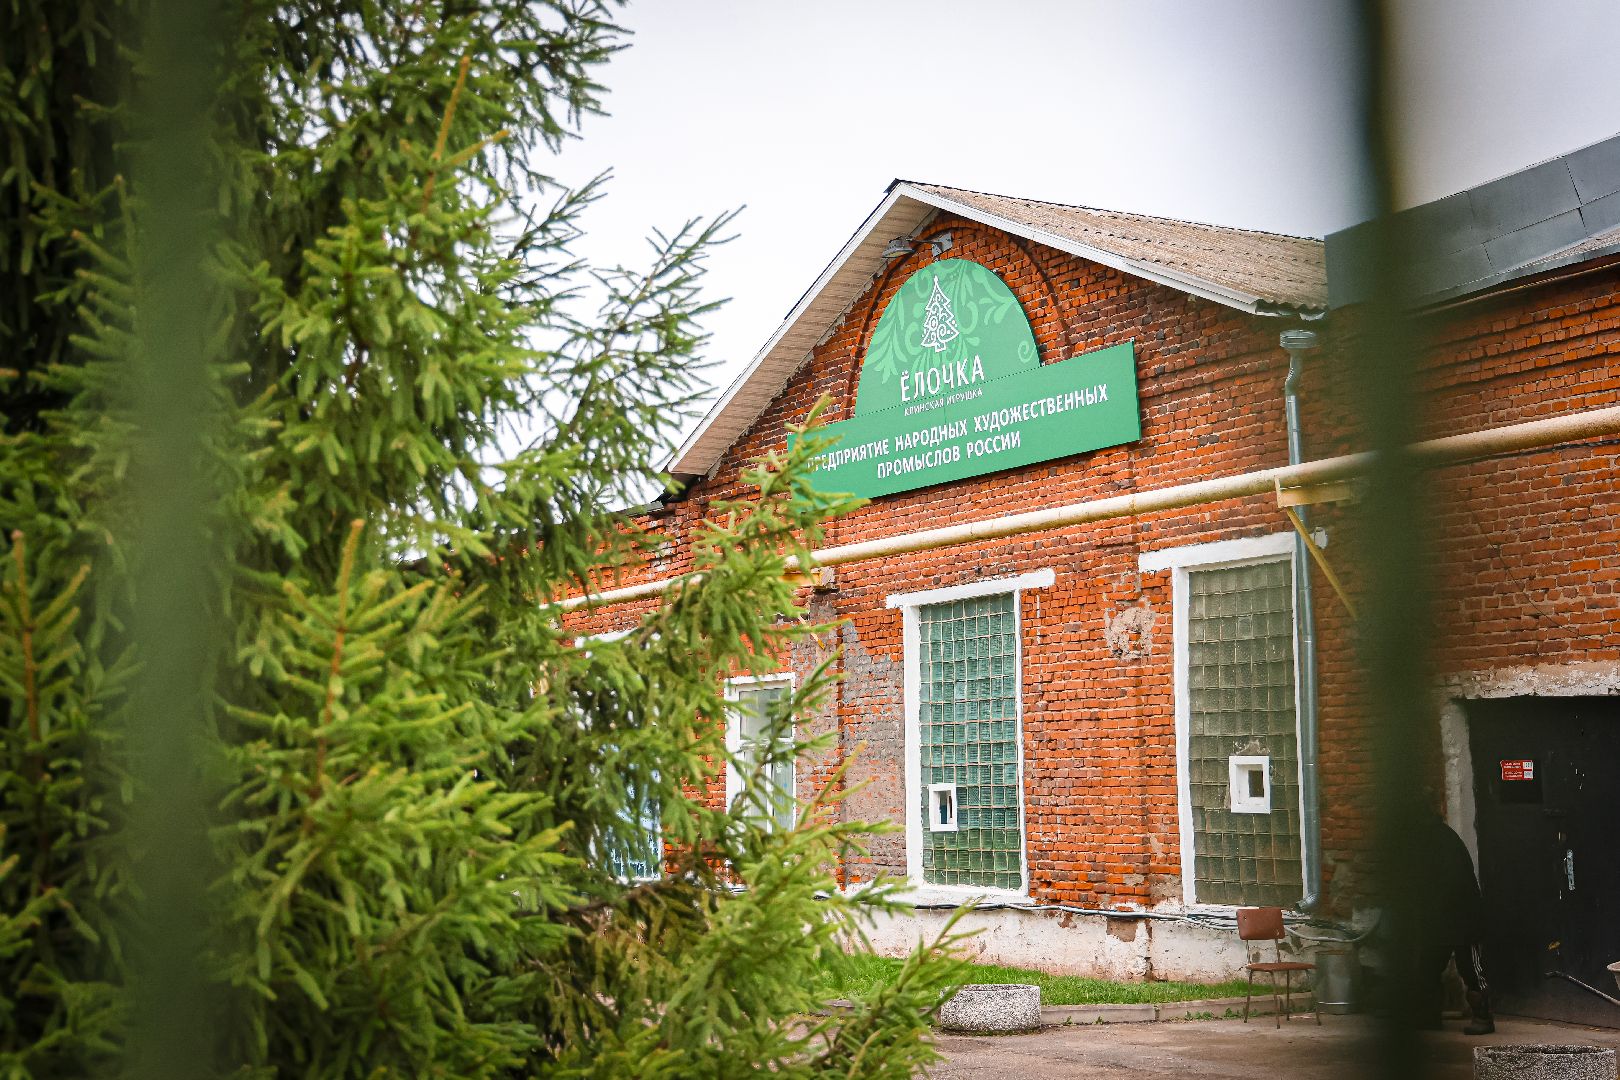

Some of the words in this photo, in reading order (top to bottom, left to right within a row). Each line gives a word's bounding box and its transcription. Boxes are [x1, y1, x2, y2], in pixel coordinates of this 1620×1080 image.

[900, 354, 985, 402] ЁЛОЧКА
[904, 397, 944, 416] КЛИНСКАЯ
[946, 387, 983, 406] ИГРУШКА
[895, 418, 968, 452] НАРОДНЫХ
[973, 383, 1109, 434] ХУДОЖЕСТВЕННЫХ
[876, 446, 961, 479] ПРОМЫСЛОВ
[966, 431, 1022, 460] РОССИИ
